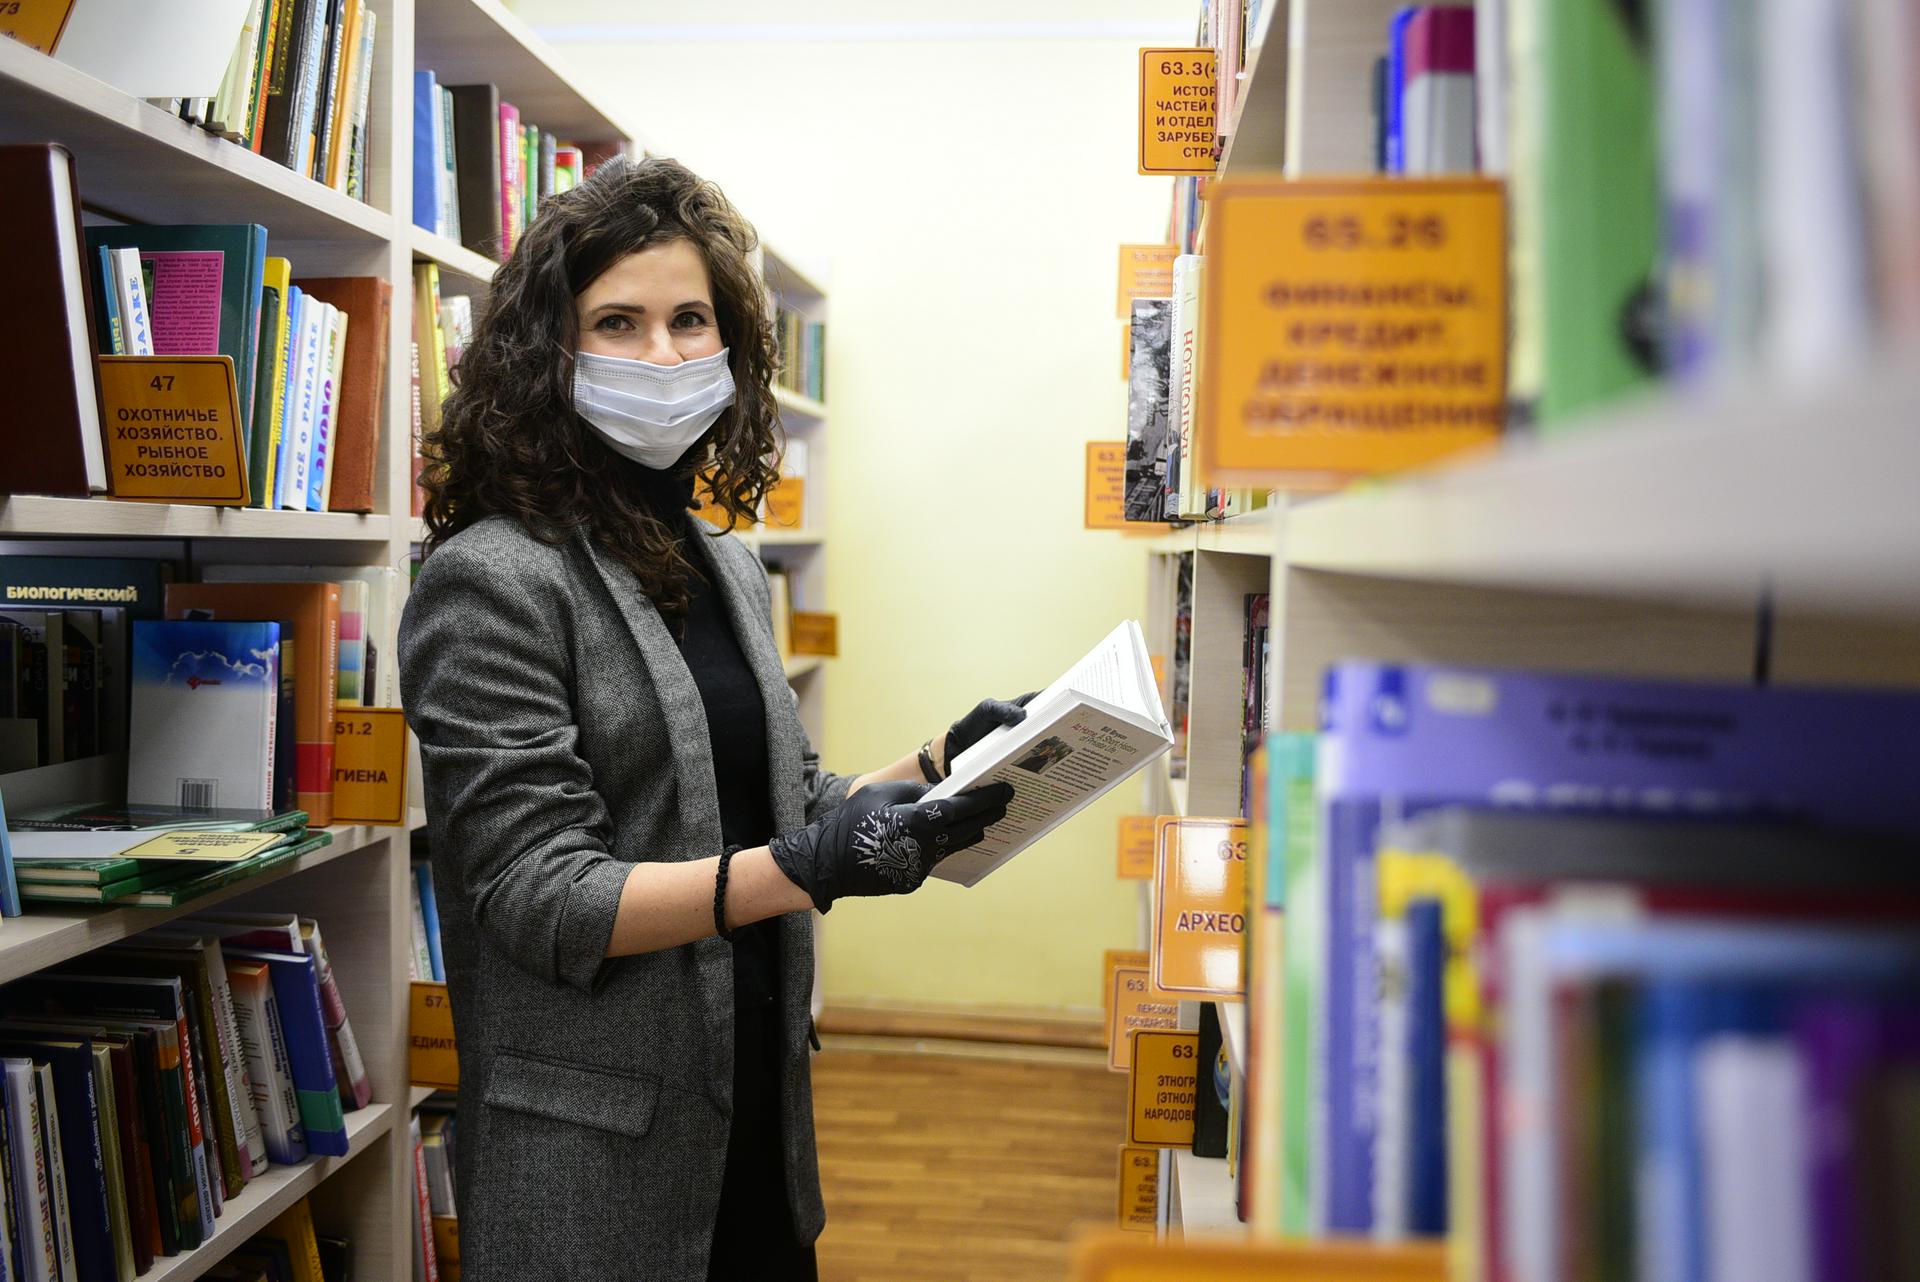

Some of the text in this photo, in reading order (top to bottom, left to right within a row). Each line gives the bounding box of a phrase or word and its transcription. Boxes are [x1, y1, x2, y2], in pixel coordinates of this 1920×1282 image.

[1156, 99, 1208, 112] ЧАСТЕЙ
[1156, 117, 1215, 128] И ОТДЕЛ
[1302, 213, 1449, 248] 65.26
[111, 317, 124, 355] РЫБ
[302, 322, 318, 423] РЫБАЛКЕ
[150, 375, 175, 391] 47
[1180, 328, 1193, 459] НАПОЛЕОН
[117, 408, 219, 422] ОХОТНИЧЬЕ
[116, 426, 223, 441] ХОЗЯЙСТВО.
[137, 446, 208, 459] РЫБНОЕ
[125, 463, 226, 479] ХОЗЯЙСТВО
[6, 586, 138, 602] БИОЛОГИЧЕСКИЙ
[335, 721, 372, 737] 51.2
[335, 768, 388, 784] ГИЕНА
[1218, 840, 1248, 861] 63
[1176, 912, 1248, 934] АРХЕО
[30, 1100, 46, 1194] ПРИВЫЧКИ
